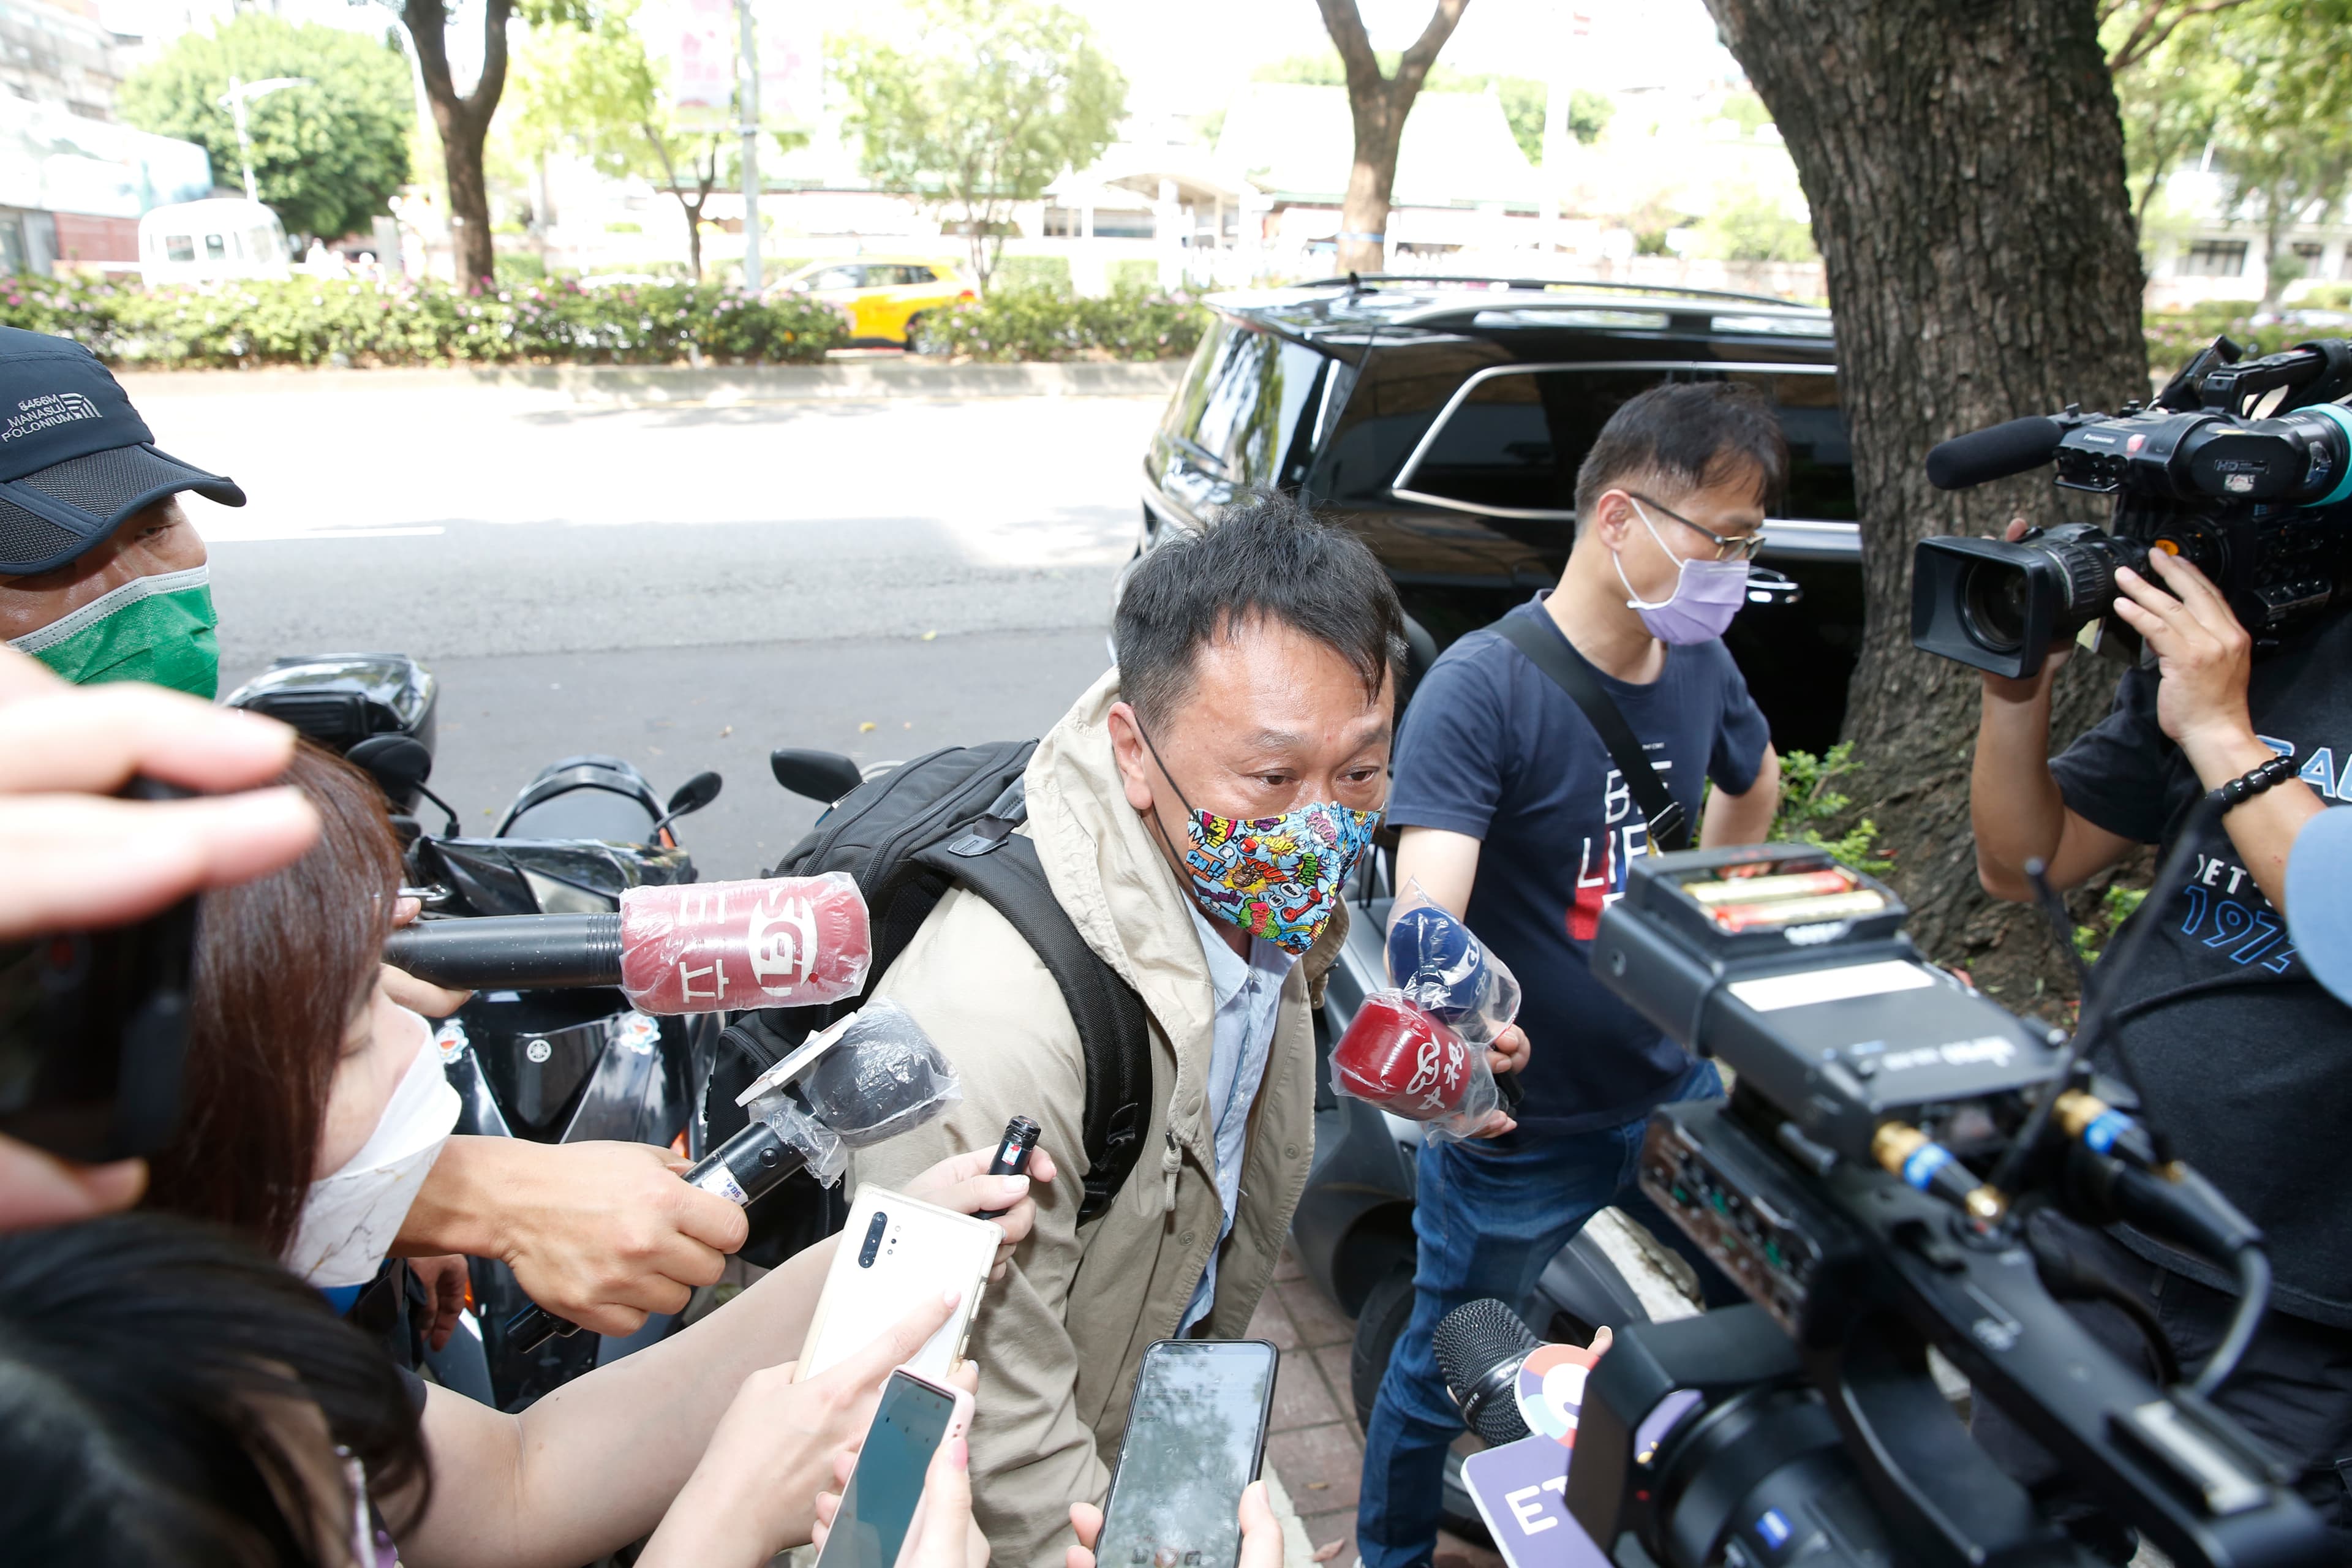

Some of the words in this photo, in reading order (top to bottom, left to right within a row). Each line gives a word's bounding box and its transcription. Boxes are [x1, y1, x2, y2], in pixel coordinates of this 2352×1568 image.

[7, 402, 66, 428] MANASLU
[18, 394, 60, 411] 8456M
[1, 412, 73, 442] POLONIUM
[678, 891, 729, 1004] 三立
